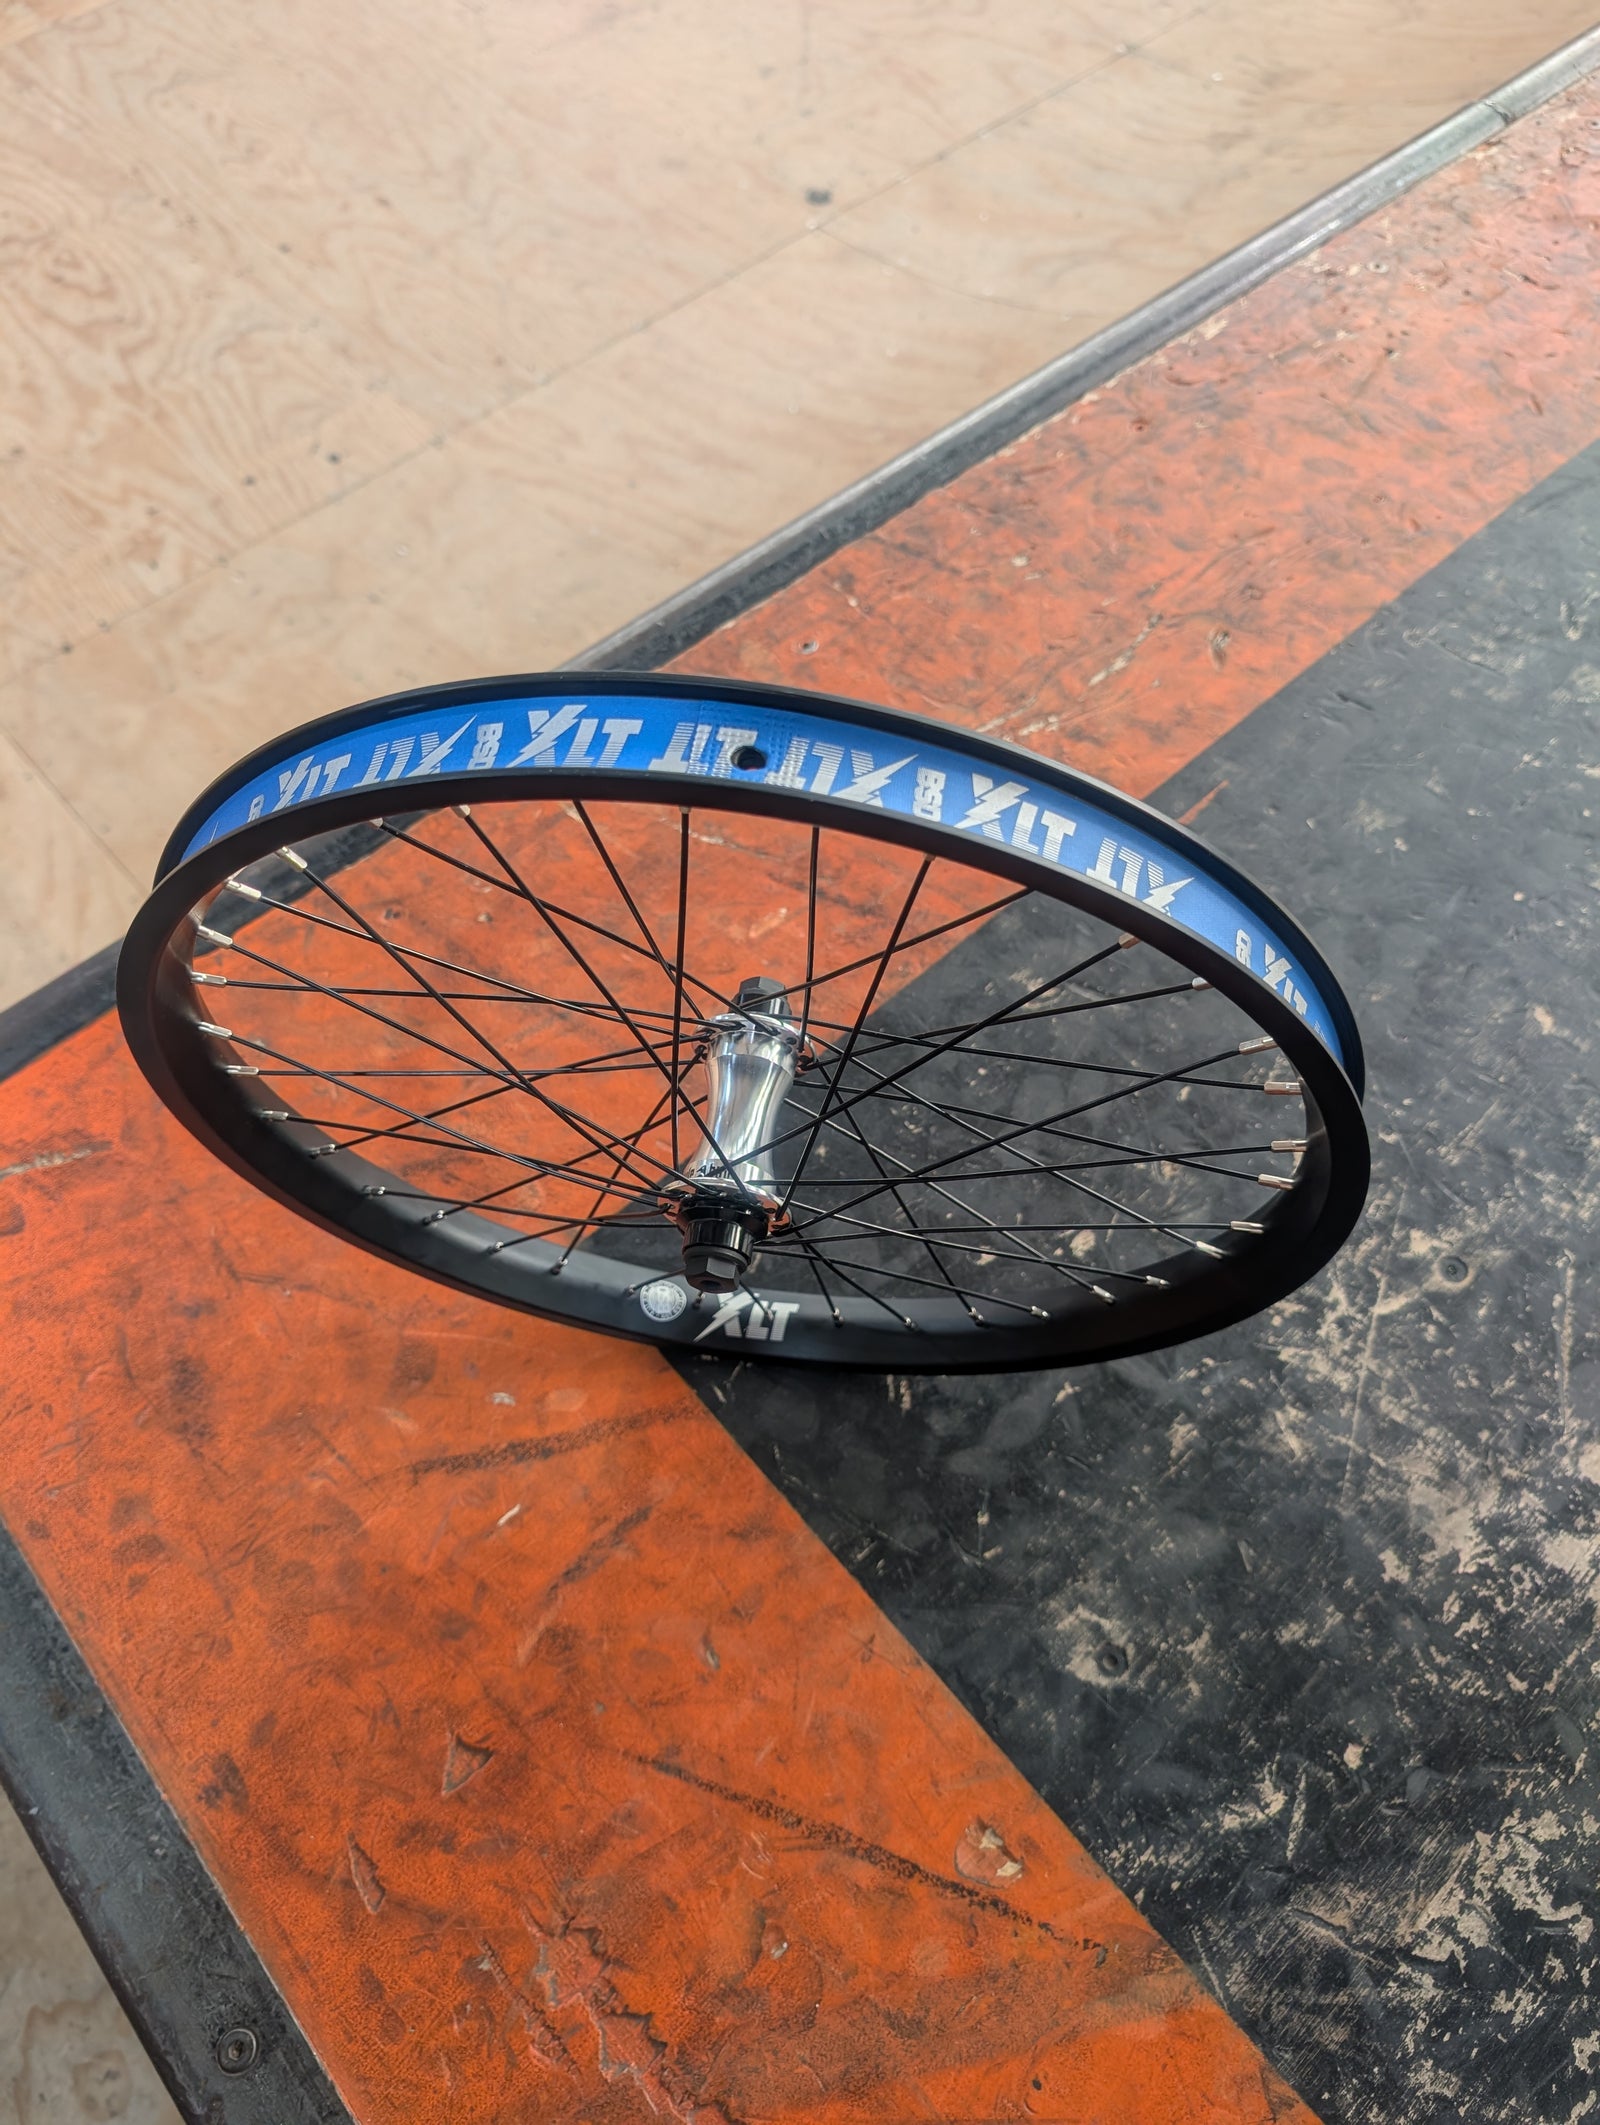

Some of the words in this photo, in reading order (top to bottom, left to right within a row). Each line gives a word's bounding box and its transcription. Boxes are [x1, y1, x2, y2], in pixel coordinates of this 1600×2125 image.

[514, 704, 644, 768] XLT
[764, 737, 919, 808] XLT
[953, 772, 1077, 864] XLT
[692, 1290, 800, 1342] XLT
